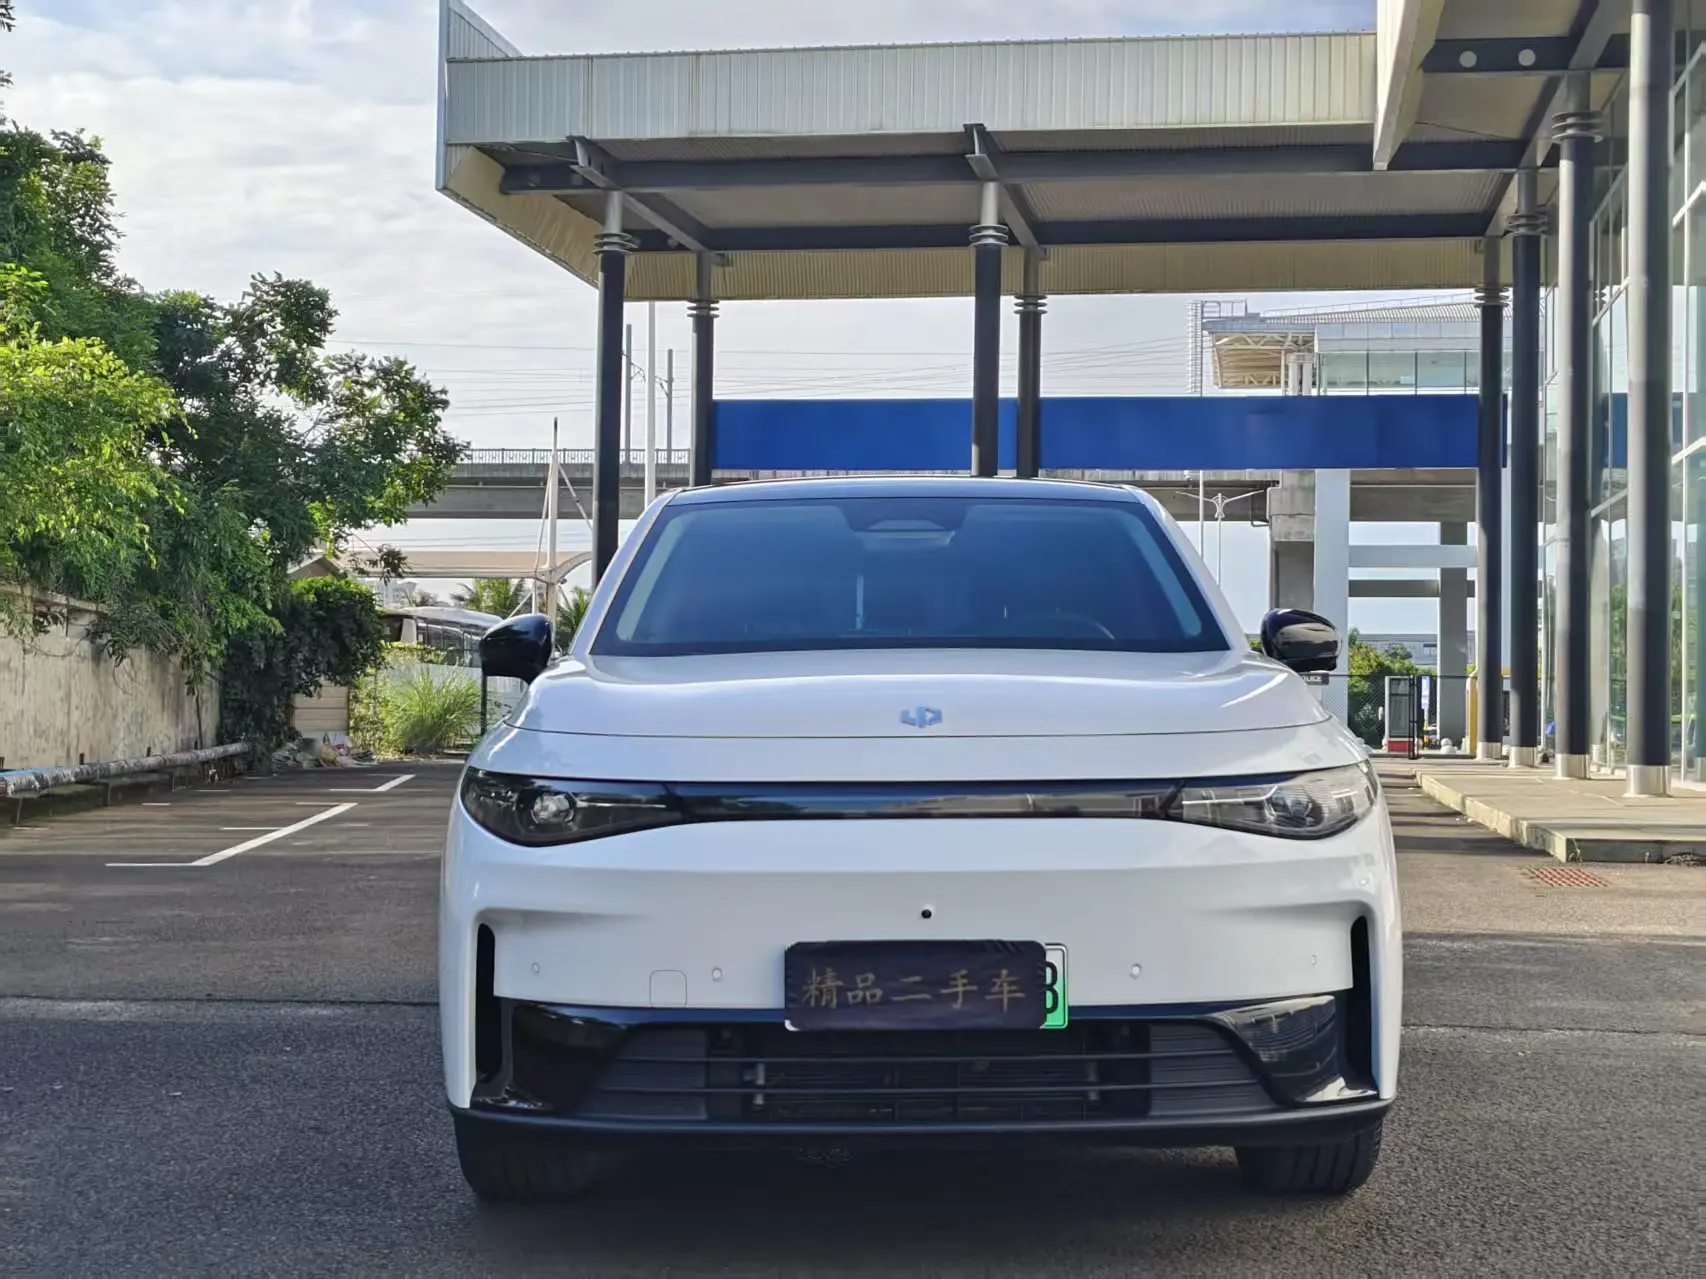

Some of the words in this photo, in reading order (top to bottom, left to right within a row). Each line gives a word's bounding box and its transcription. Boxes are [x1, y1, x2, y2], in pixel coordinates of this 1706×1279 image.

[802, 967, 1026, 1012] 精品二手车
